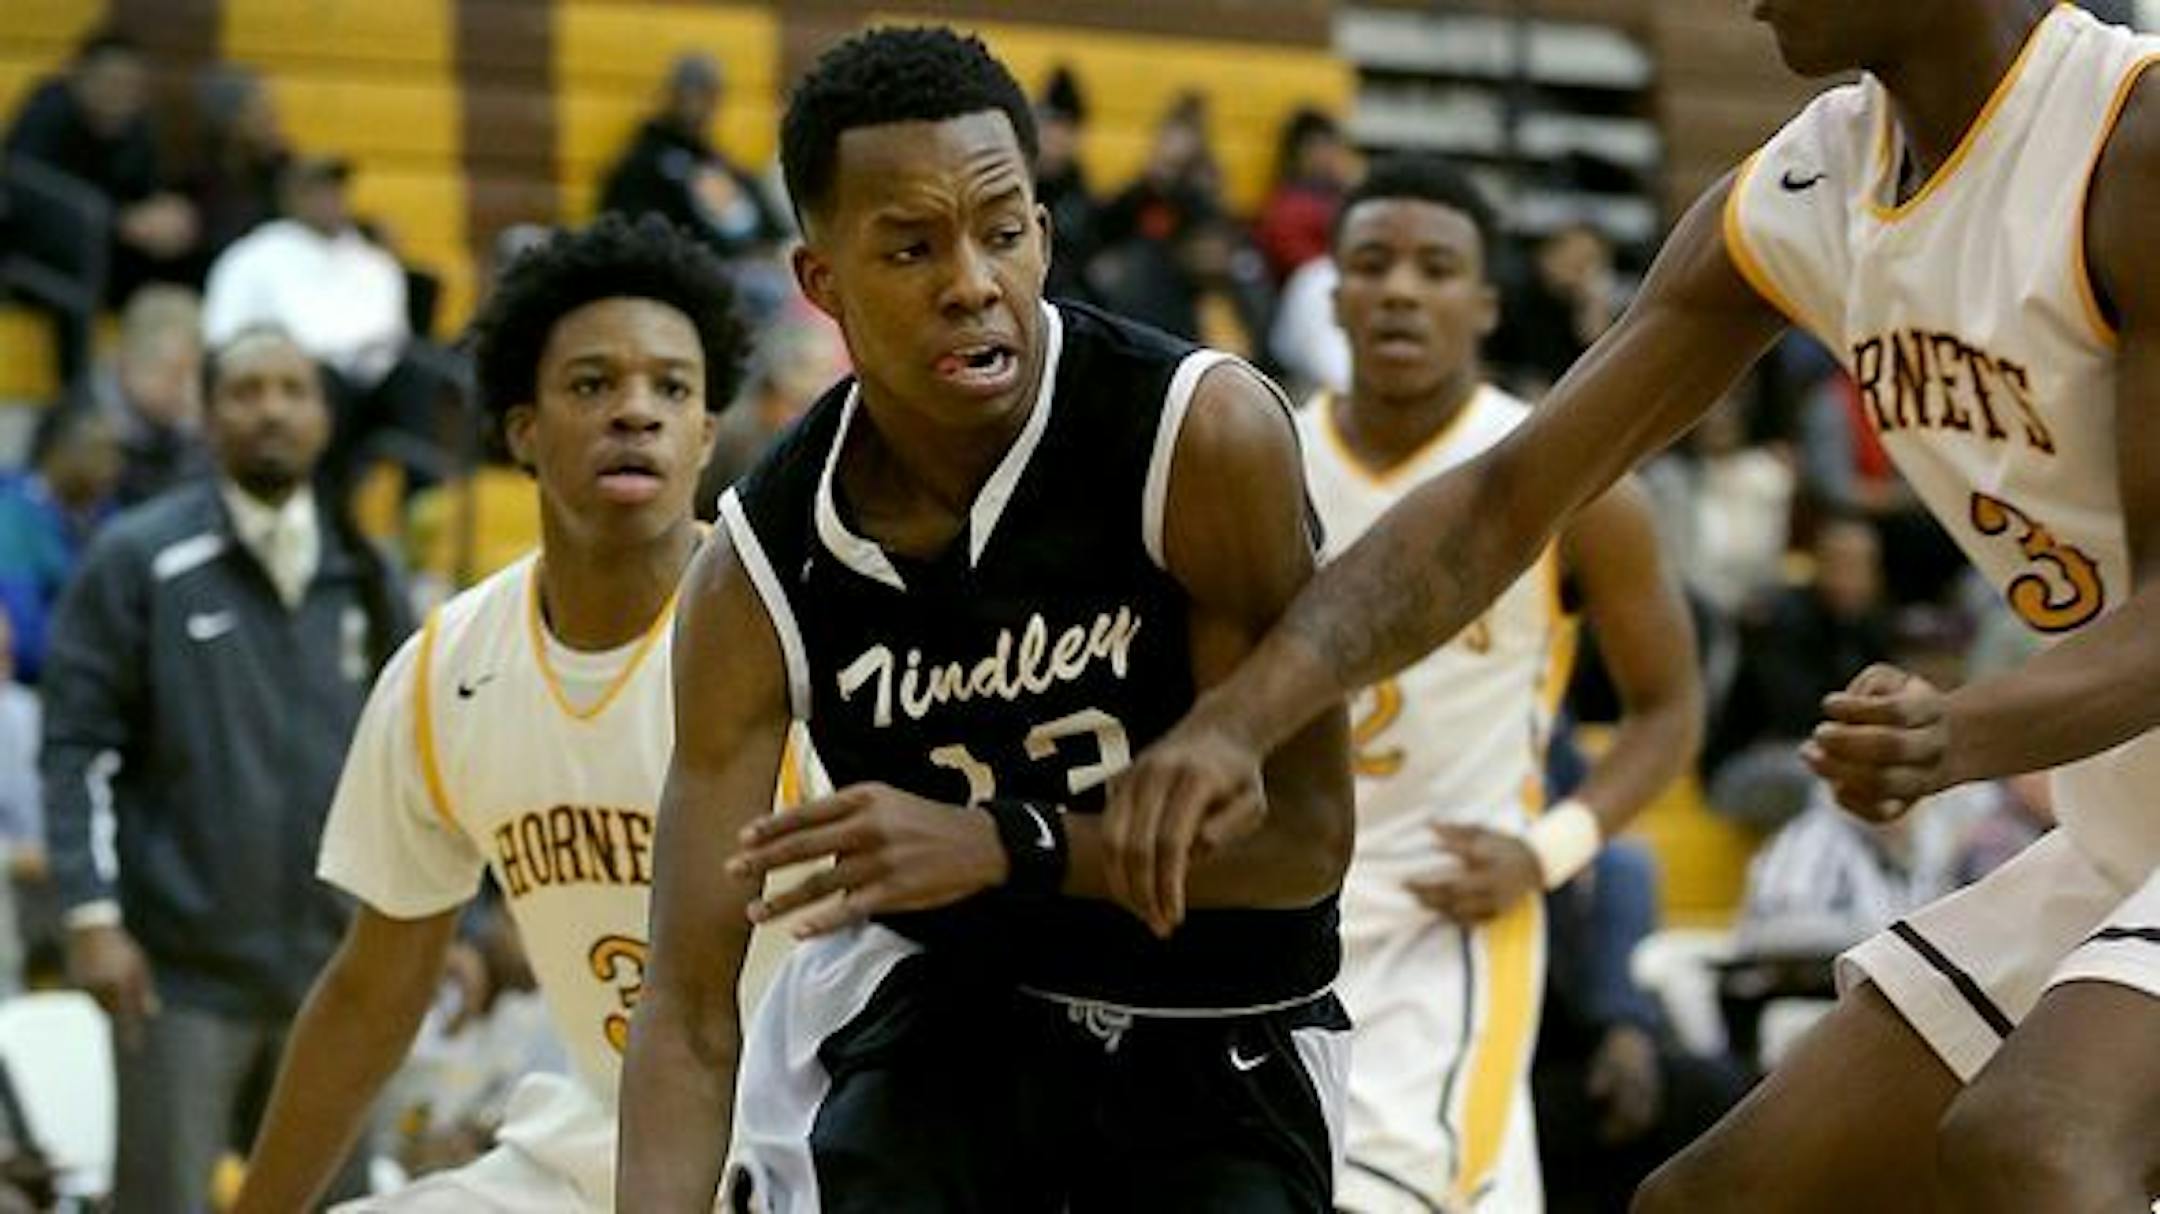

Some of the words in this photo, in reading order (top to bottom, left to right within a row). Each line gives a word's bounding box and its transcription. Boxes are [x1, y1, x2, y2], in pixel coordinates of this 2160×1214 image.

[1853, 328, 2056, 455] RNETS
[1971, 491, 2104, 633] 3
[836, 604, 1142, 728] Tindley
[496, 804, 655, 898] HORNE
